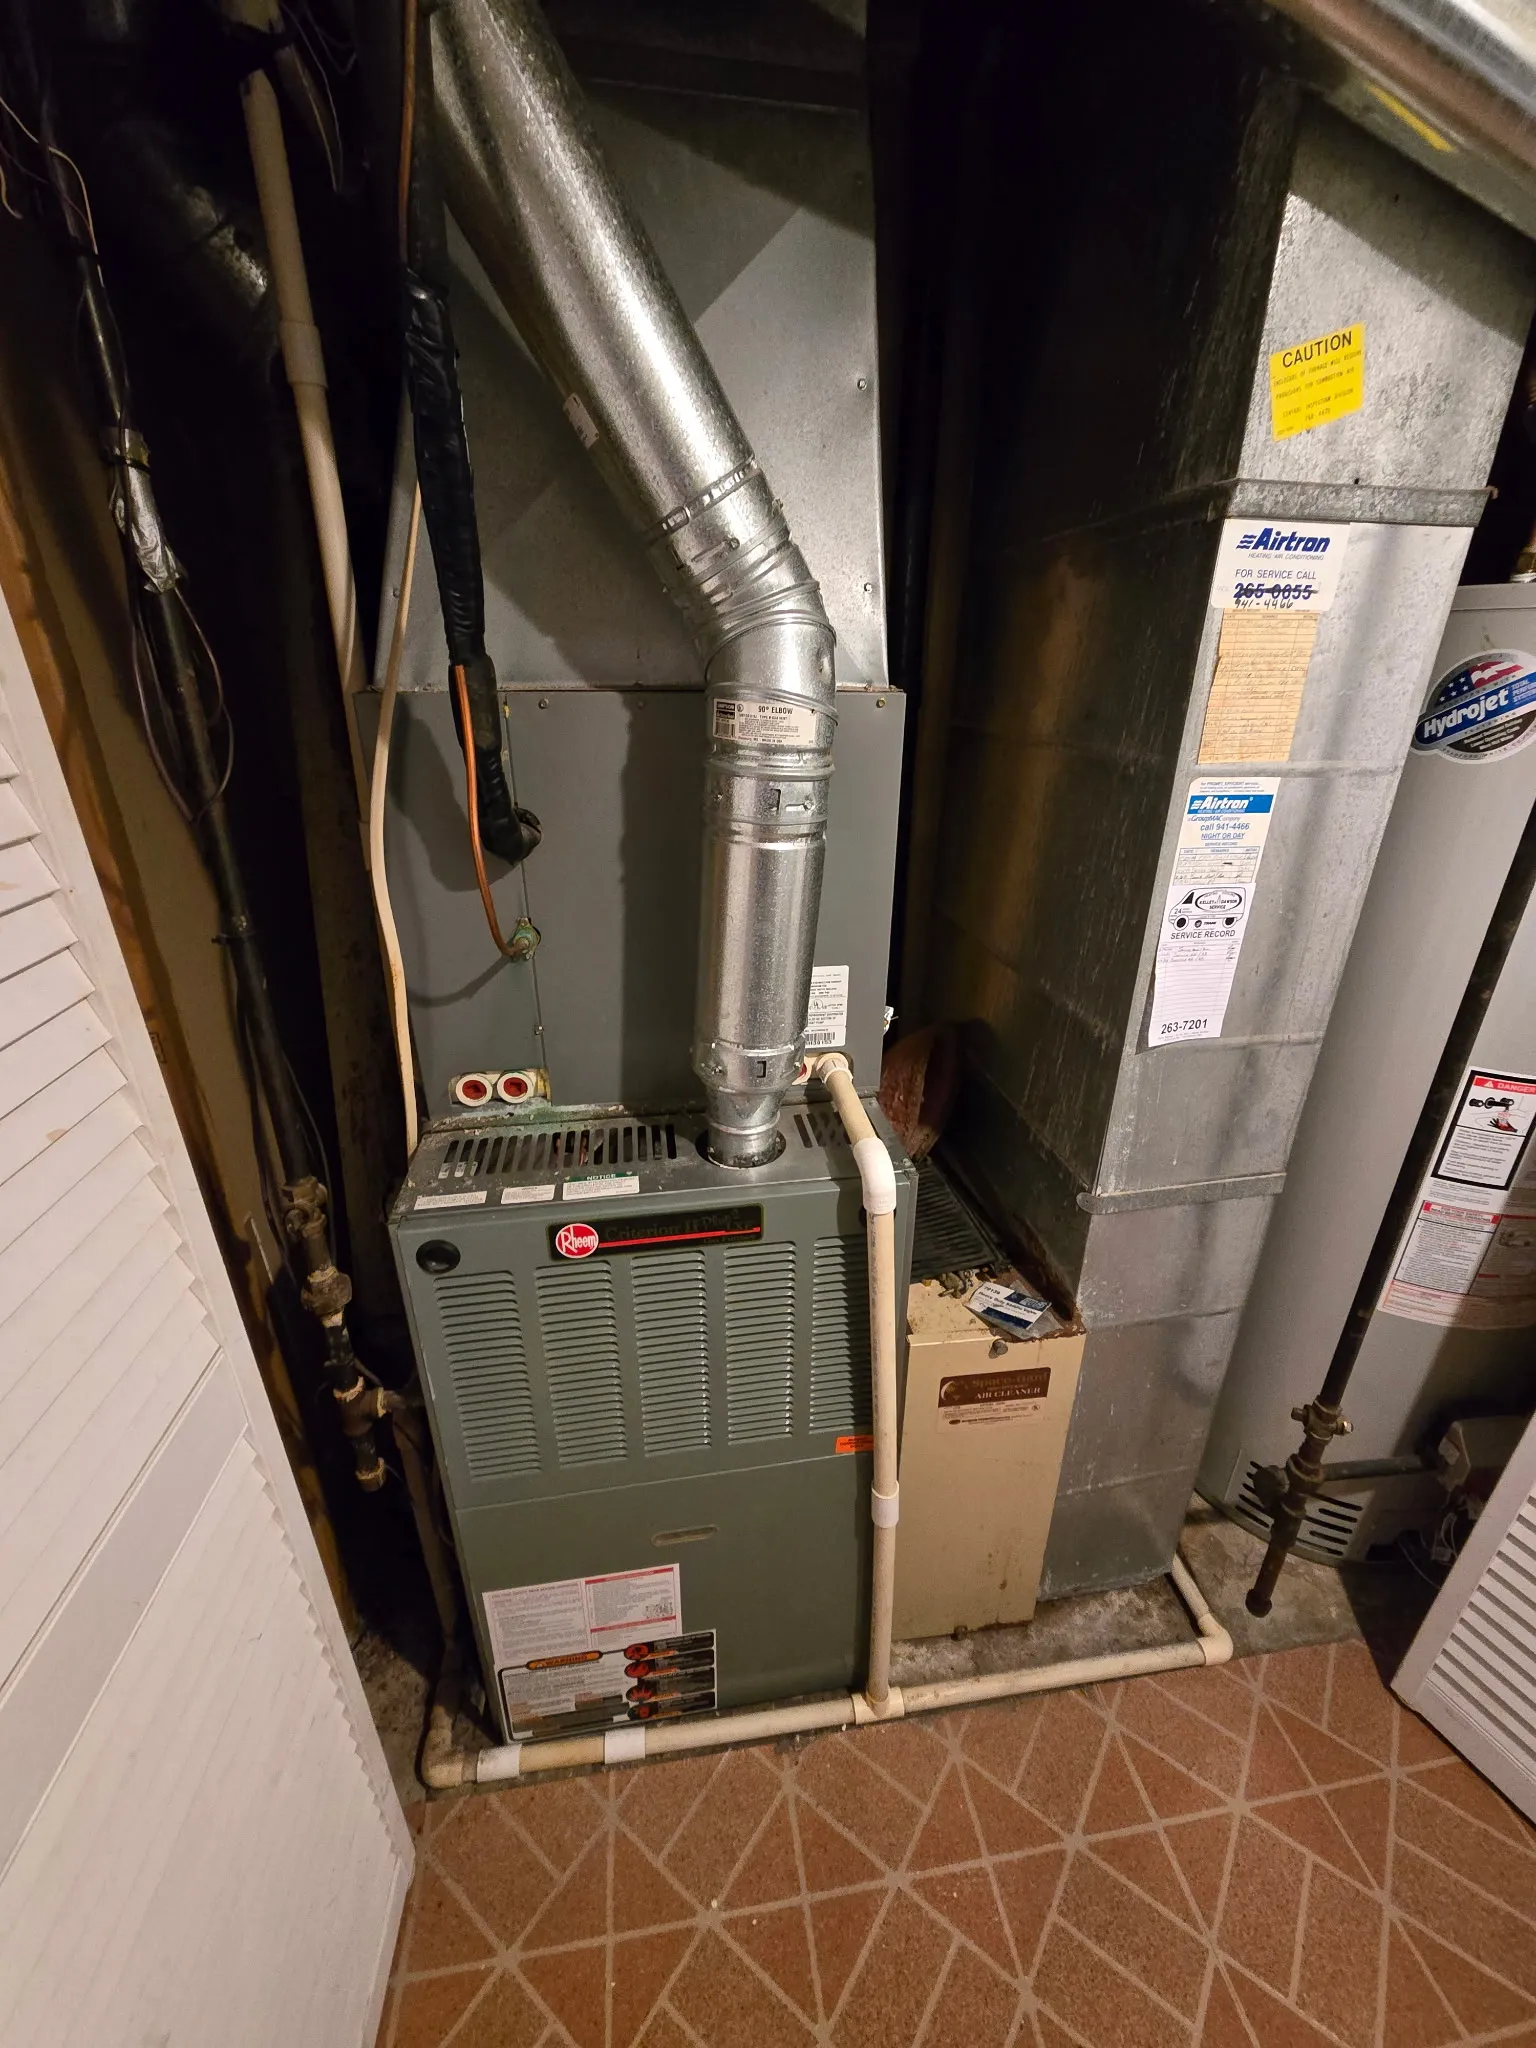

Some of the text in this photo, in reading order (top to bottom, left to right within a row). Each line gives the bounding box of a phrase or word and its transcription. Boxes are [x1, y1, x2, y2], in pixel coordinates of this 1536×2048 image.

[1282, 331, 1352, 368] CAUTION
[1252, 528, 1330, 552] Airtron
[1235, 569, 1316, 580] FOR SERVICE CALL
[1423, 688, 1509, 738] Hydrojet
[1200, 796, 1249, 810] Airtron
[1161, 1018, 1208, 1034] 263-7201
[1497, 1083, 1536, 1094] DANGER
[560, 1225, 597, 1253] Rheem
[606, 1224, 680, 1241] Criterion
[994, 1387, 1040, 1397] CLEANER
[546, 1654, 587, 1665] WARNING
